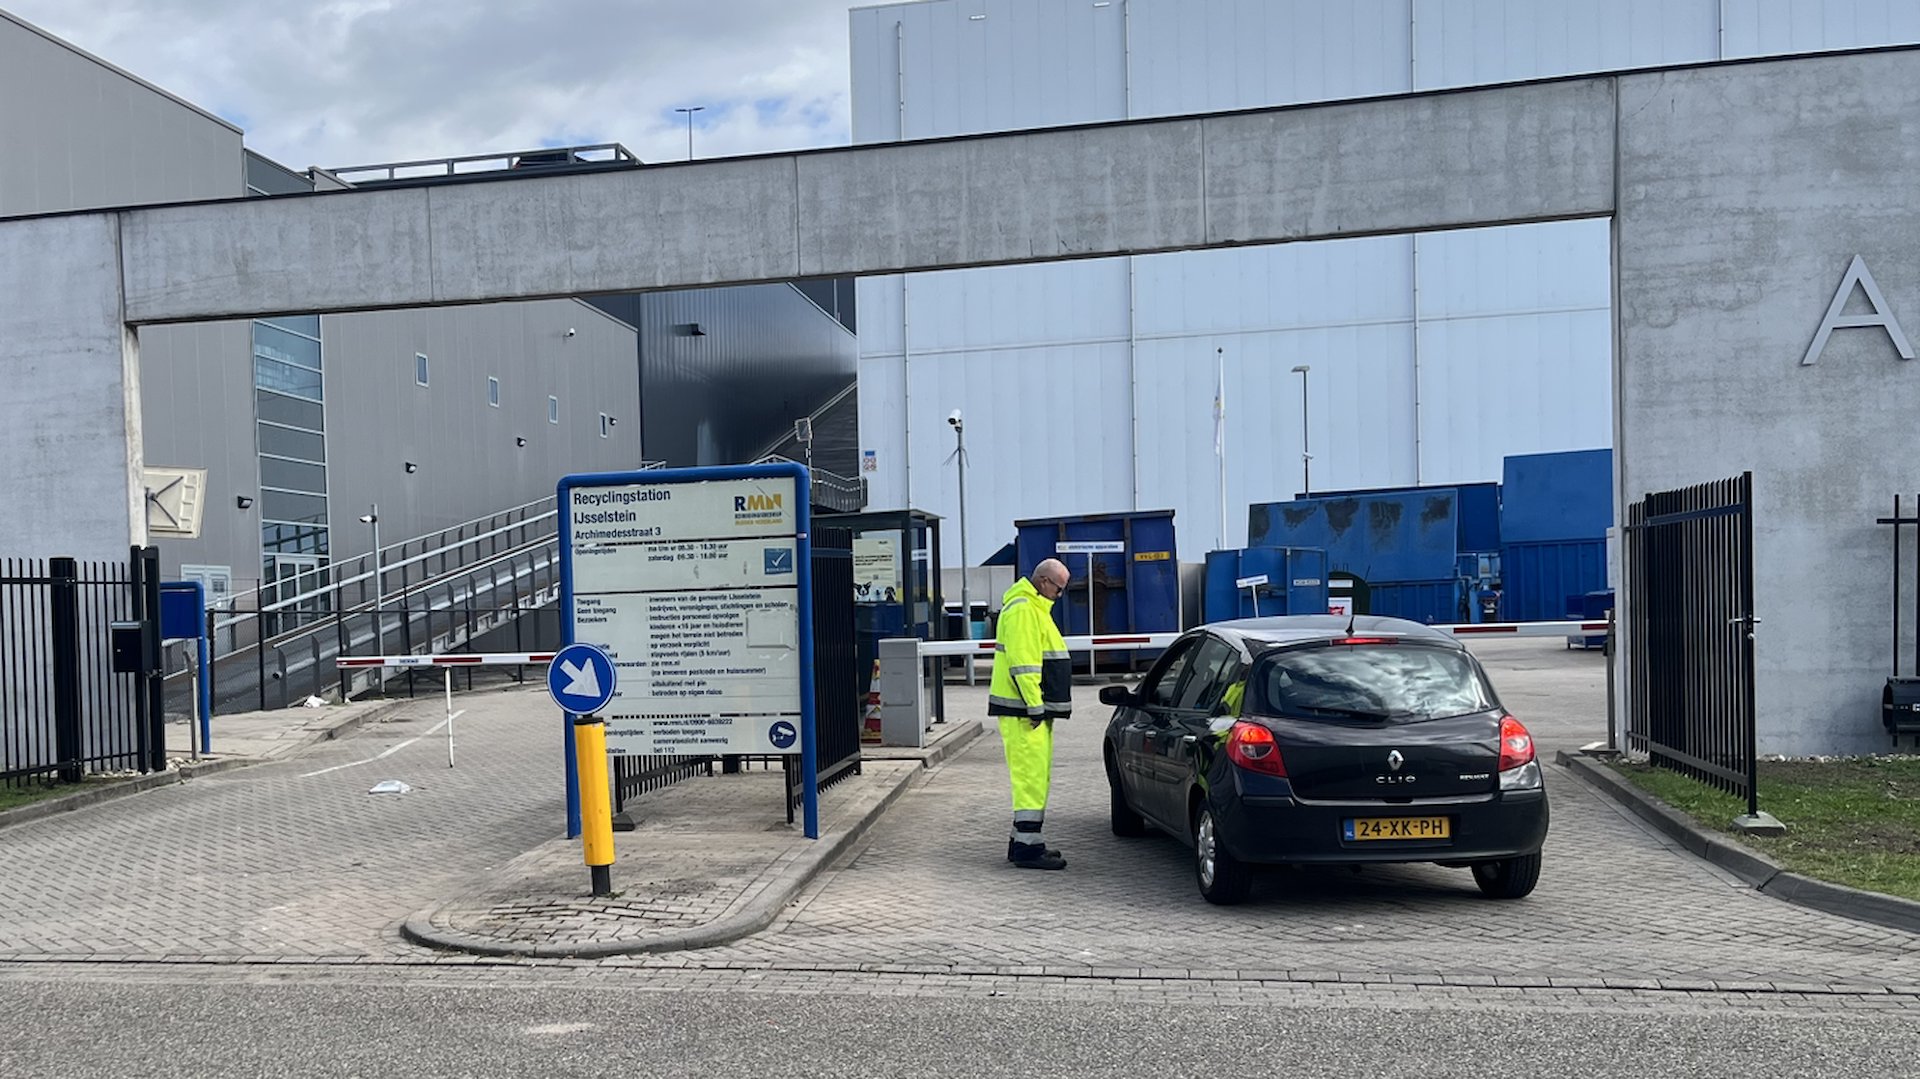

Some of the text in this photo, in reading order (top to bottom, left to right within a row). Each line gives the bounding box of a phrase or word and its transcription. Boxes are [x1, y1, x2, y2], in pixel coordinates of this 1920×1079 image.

[1802, 253, 1915, 366] A
[574, 489, 671, 506] Recyclingstation
[734, 494, 782, 512] RMN
[574, 510, 636, 524] IJsselstein
[575, 527, 662, 540] Archimedesstraat 3
[1375, 775, 1417, 784] CLIO
[1360, 819, 1443, 837] 24-XK-PH
